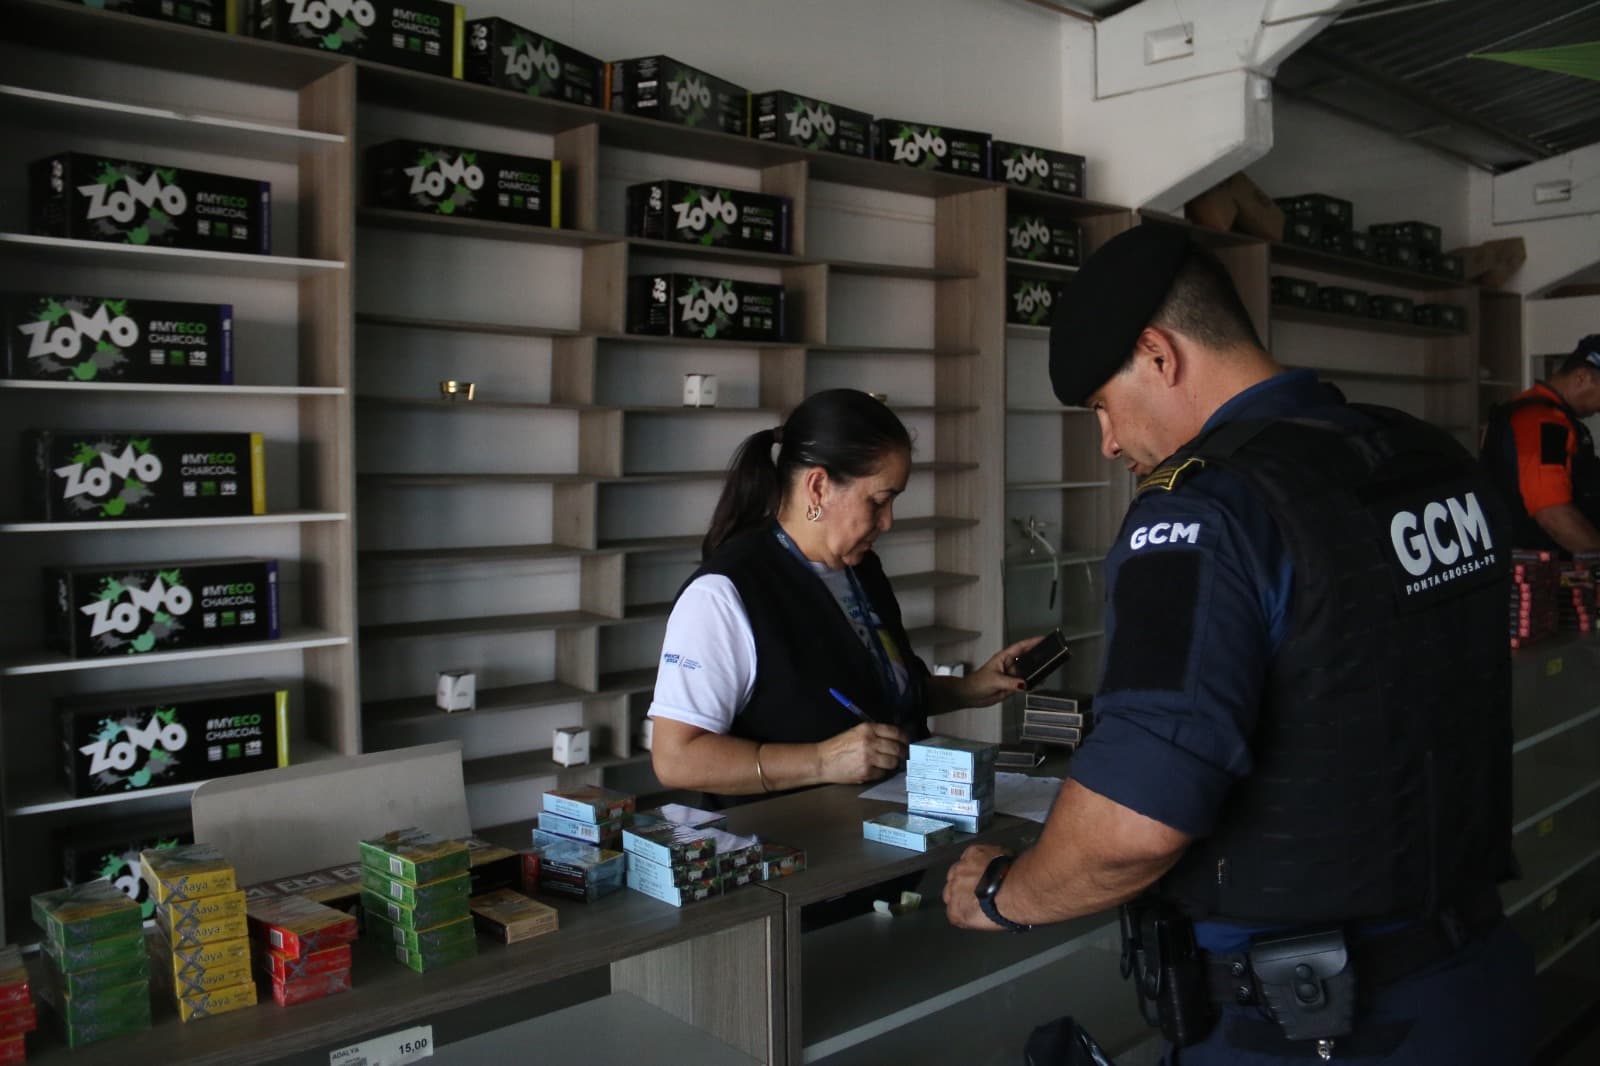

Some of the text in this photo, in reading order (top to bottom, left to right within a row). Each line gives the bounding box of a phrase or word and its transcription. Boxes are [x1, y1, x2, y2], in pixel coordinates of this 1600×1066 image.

[500, 40, 560, 80] ZOMO
[666, 77, 711, 110] ZOMO
[785, 106, 836, 140] ZOMO
[888, 129, 948, 163] ZOMO
[402, 153, 485, 196] ZOMO
[1003, 152, 1049, 182] ZOMO
[76, 171, 188, 223] ZOMO
[672, 192, 738, 231] ZOMO
[1009, 218, 1050, 249] ZOMO
[677, 284, 739, 322] ZOMO
[1013, 285, 1052, 312] ZOMO
[18, 304, 139, 359] ZOMO
[148, 333, 208, 345] CHARCOAL
[149, 321, 208, 334] #MYECO
[53, 444, 162, 499] ZOMO
[180, 465, 237, 476] CHARCOAL
[181, 452, 237, 465] #MYECO
[1130, 522, 1200, 550] GCM
[1390, 491, 1493, 577] GCM
[202, 582, 256, 597] #MYECO
[1406, 574, 1441, 596] PONTA
[79, 575, 194, 638] ZOMO
[201, 595, 256, 608] CHARCOAL
[205, 727, 263, 742] CHARCOAL
[206, 714, 262, 730] #MYECO
[78, 714, 189, 776] ZOMO
[399, 1038, 428, 1055] 15,00
